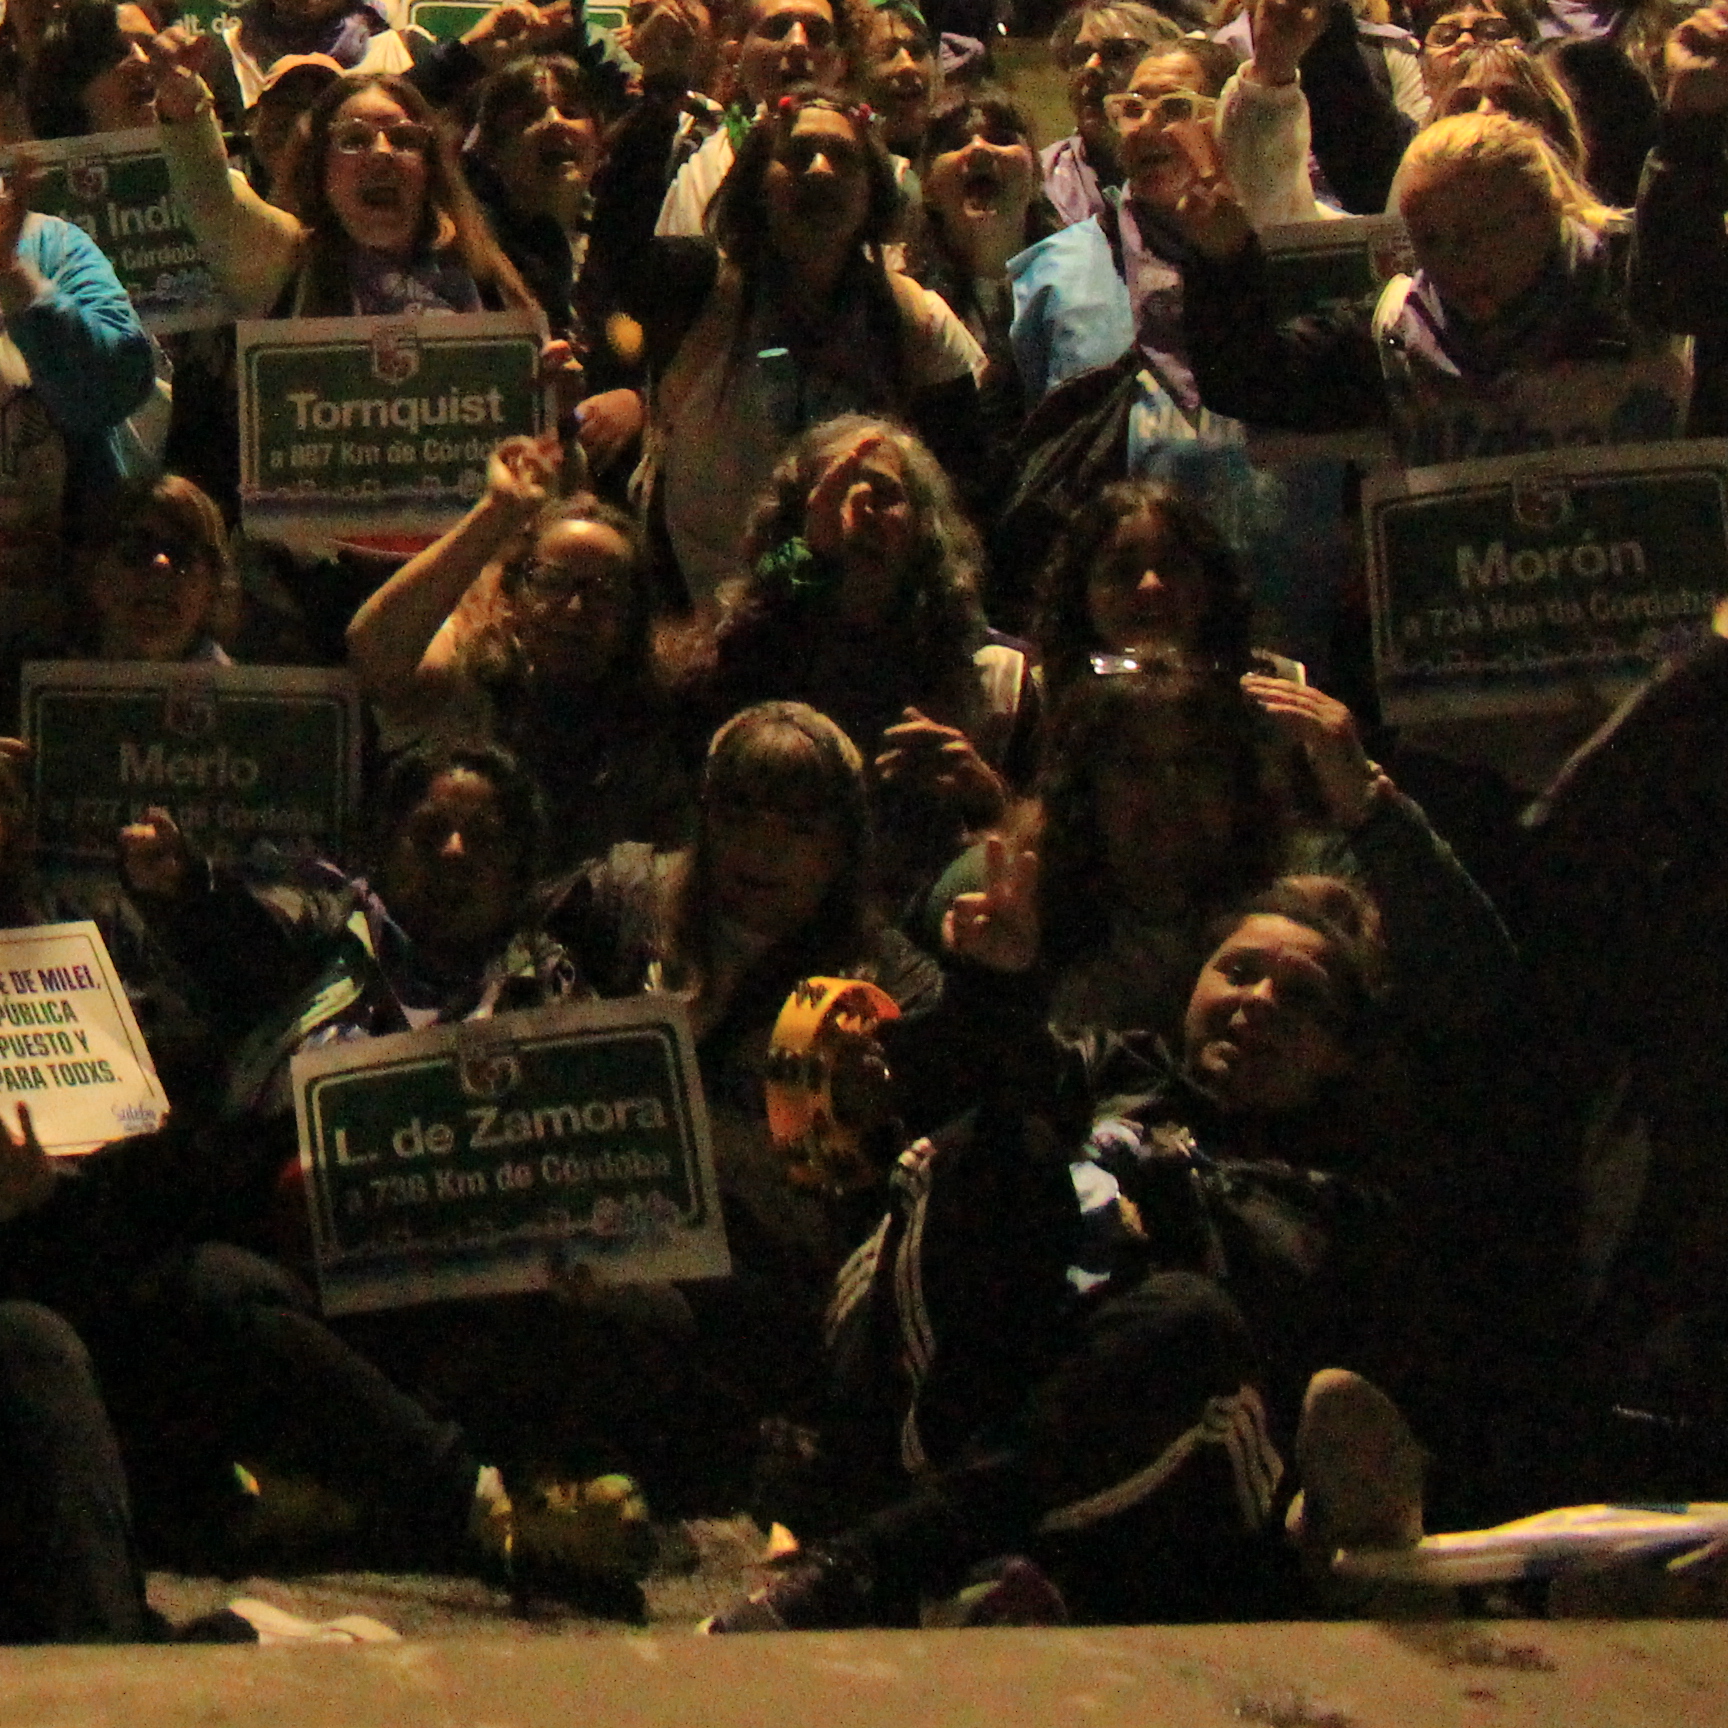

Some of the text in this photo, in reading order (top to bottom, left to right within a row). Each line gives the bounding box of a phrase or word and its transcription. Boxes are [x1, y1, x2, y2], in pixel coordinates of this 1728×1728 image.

[287, 386, 505, 434] Tornquist
[341, 441, 381, 466] Km
[386, 439, 417, 464] de
[423, 436, 494, 463] Córdo
[1455, 528, 1647, 590] Morón
[118, 740, 260, 788] Merlo
[12, 969, 38, 995] DE
[75, 1029, 91, 1054] Y
[392, 1116, 455, 1159] de
[464, 1096, 668, 1150] Zamora
[435, 1167, 488, 1200] Km
[495, 1161, 533, 1192] de
